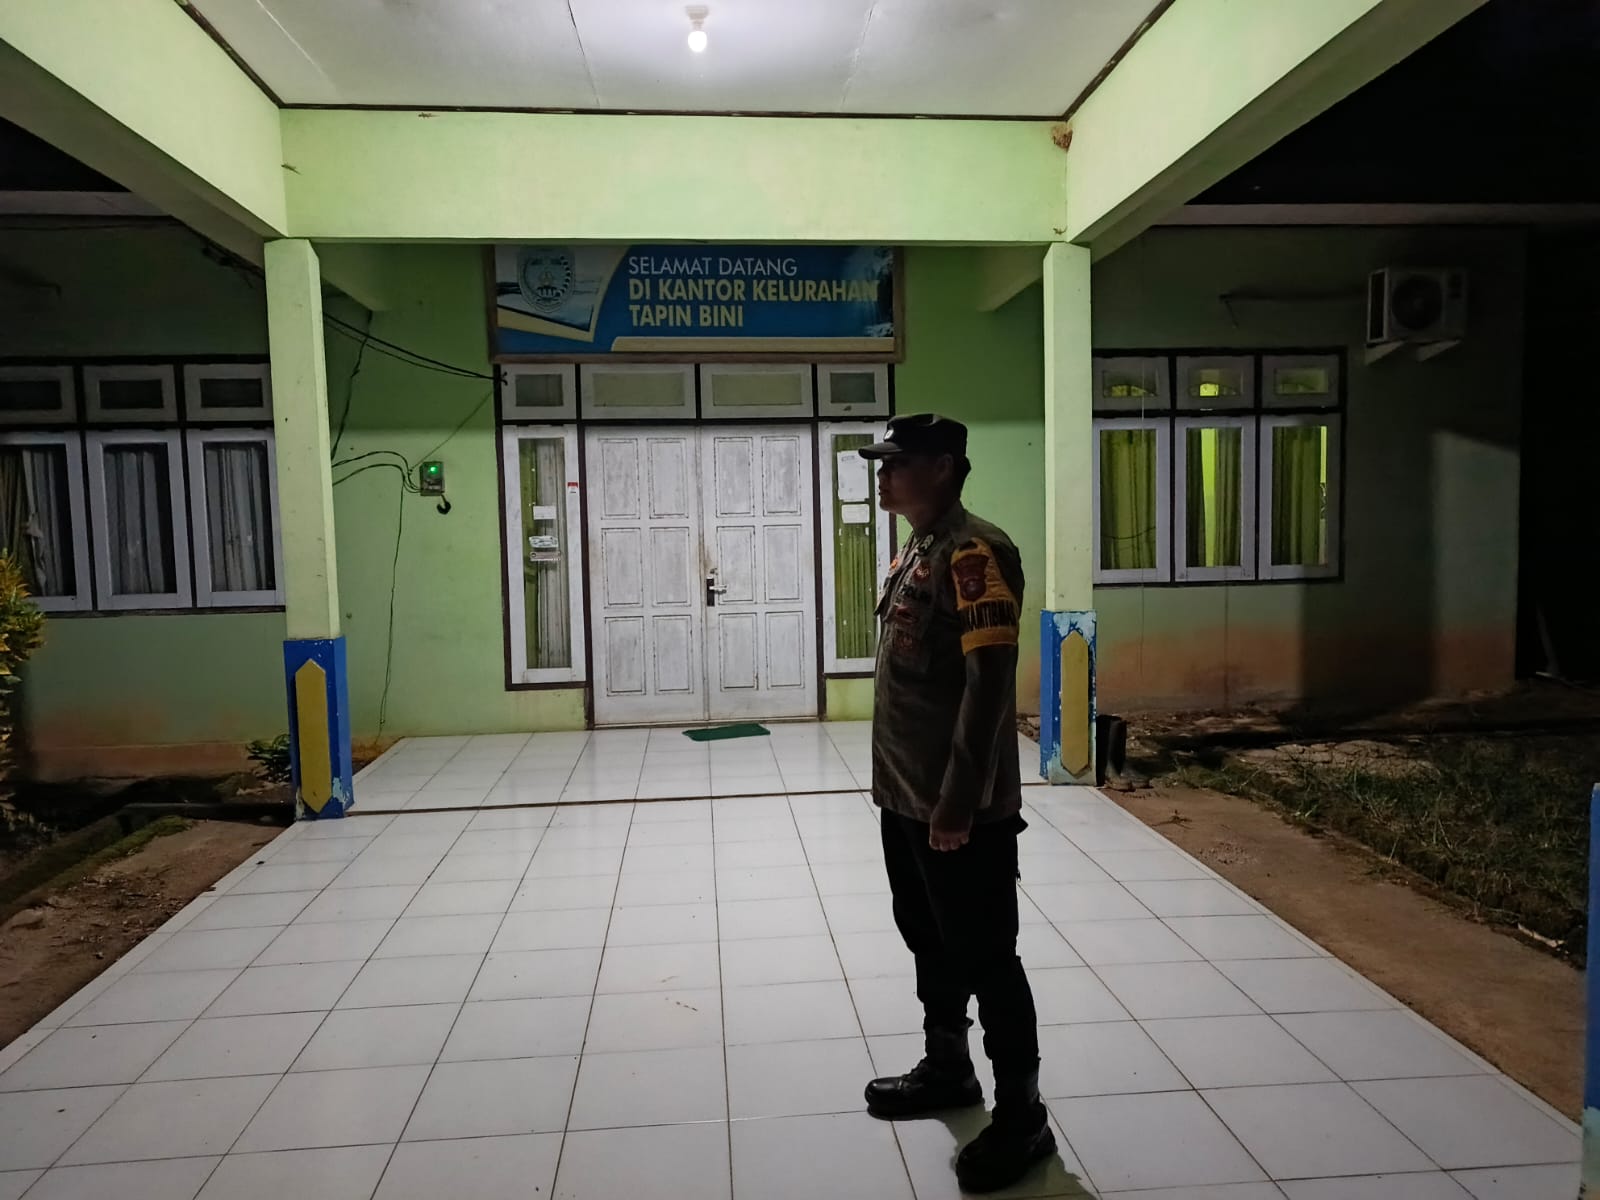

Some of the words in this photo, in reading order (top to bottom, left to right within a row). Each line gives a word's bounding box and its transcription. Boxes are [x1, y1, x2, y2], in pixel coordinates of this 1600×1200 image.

[628, 256, 712, 276] SELAMAT
[719, 257, 798, 277] DATANG
[629, 278, 651, 301] DI
[658, 279, 746, 301] KANTOR
[753, 279, 879, 303] KELURAHAN
[628, 304, 692, 328] TAPIN
[699, 305, 744, 328] BINI
